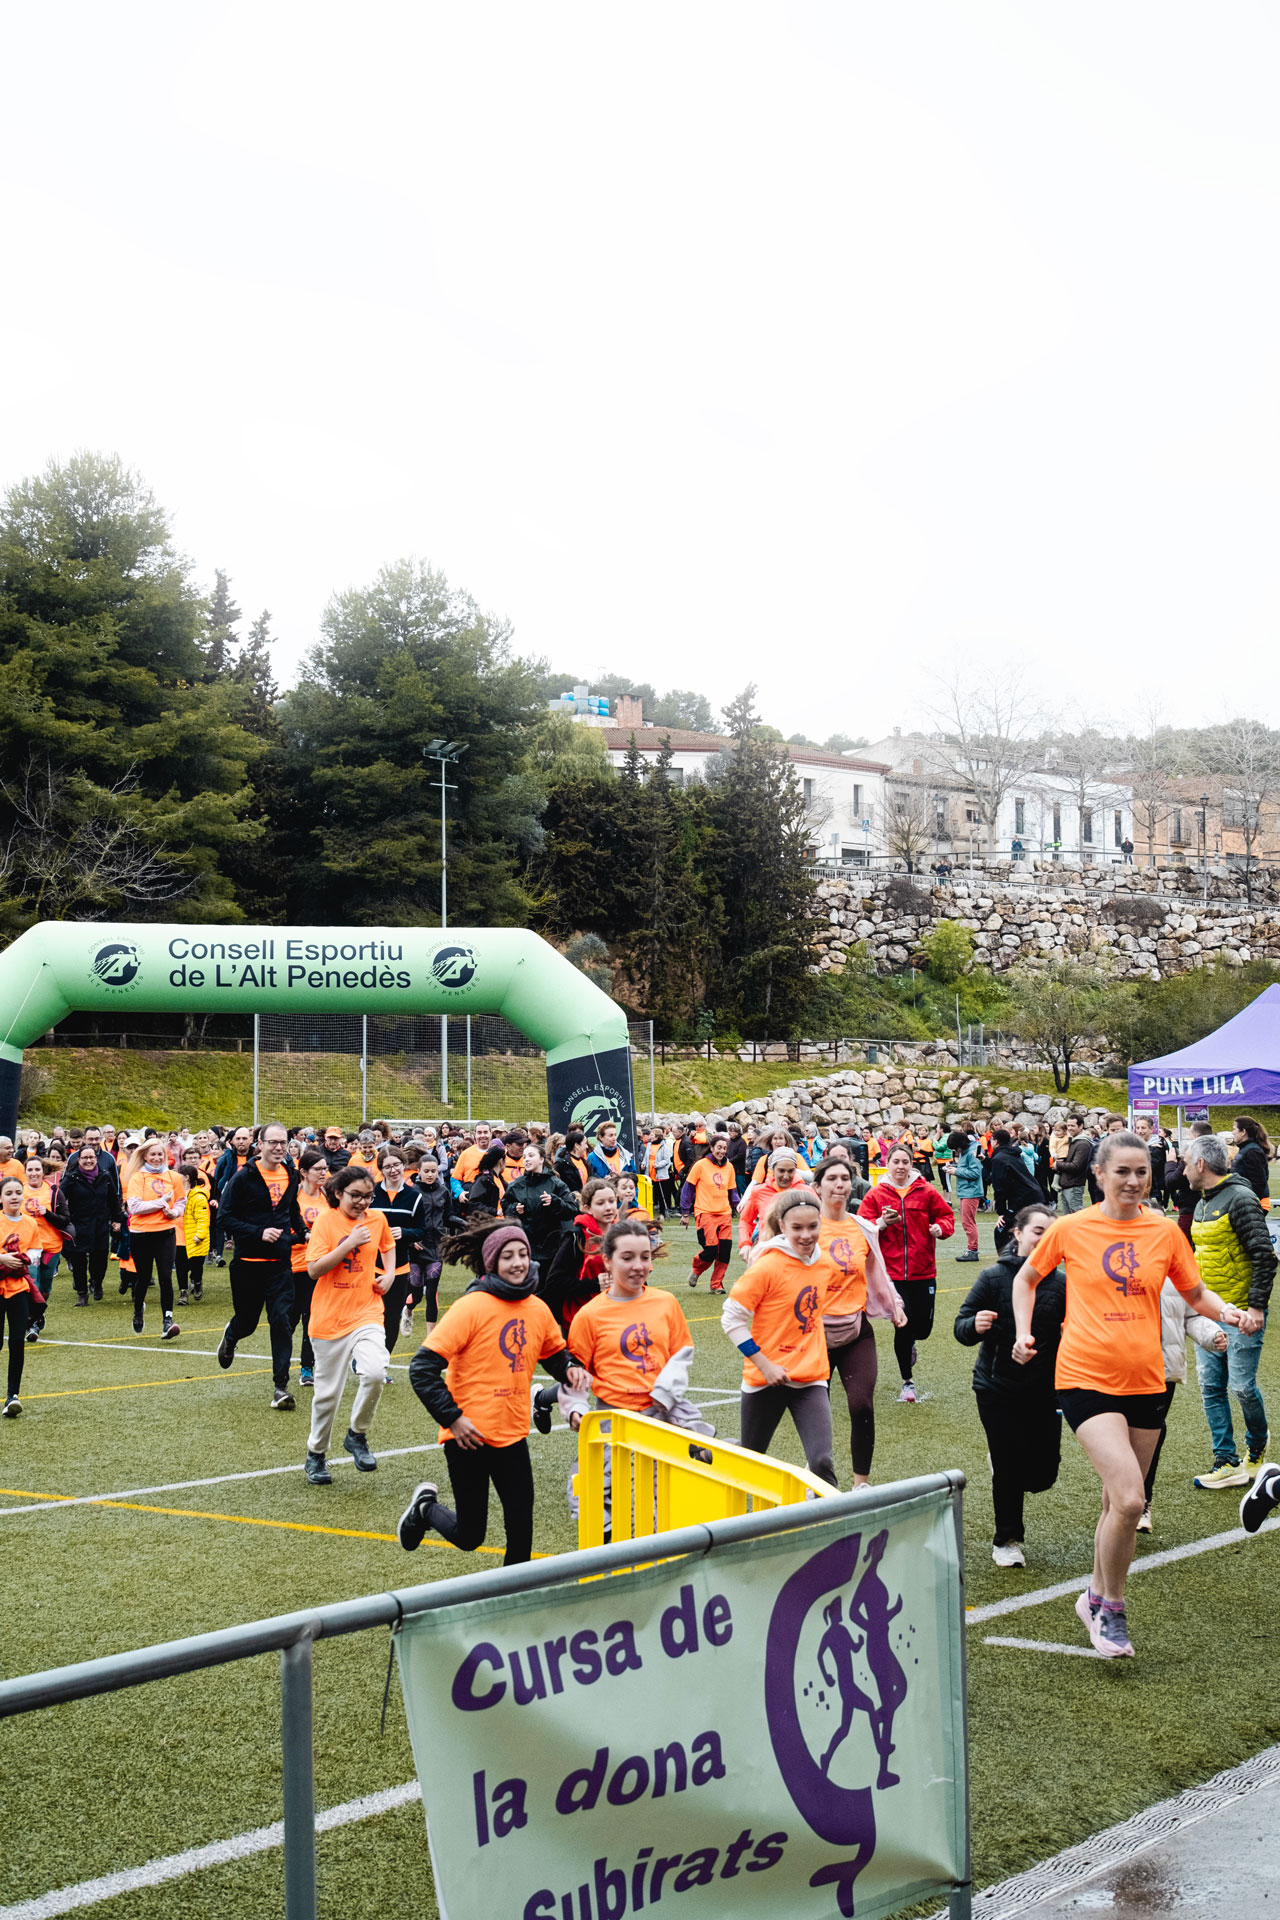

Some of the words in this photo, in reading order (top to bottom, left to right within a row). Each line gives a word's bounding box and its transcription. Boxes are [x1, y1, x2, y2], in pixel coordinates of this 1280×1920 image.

[168, 938, 275, 960] Consell
[286, 939, 403, 966] Esportiu
[169, 964, 205, 988] de
[216, 964, 277, 988] L’Alt
[288, 964, 412, 988] Penedès
[562, 1085, 592, 1113] CONSELL
[594, 1083, 627, 1108] ESPORTIU
[1143, 1076, 1194, 1095] PUNT
[1203, 1075, 1245, 1095] LILA
[451, 1619, 643, 1712] Cursa
[660, 1584, 733, 1659] de
[473, 1769, 528, 1847] la
[555, 1730, 726, 1815] dona
